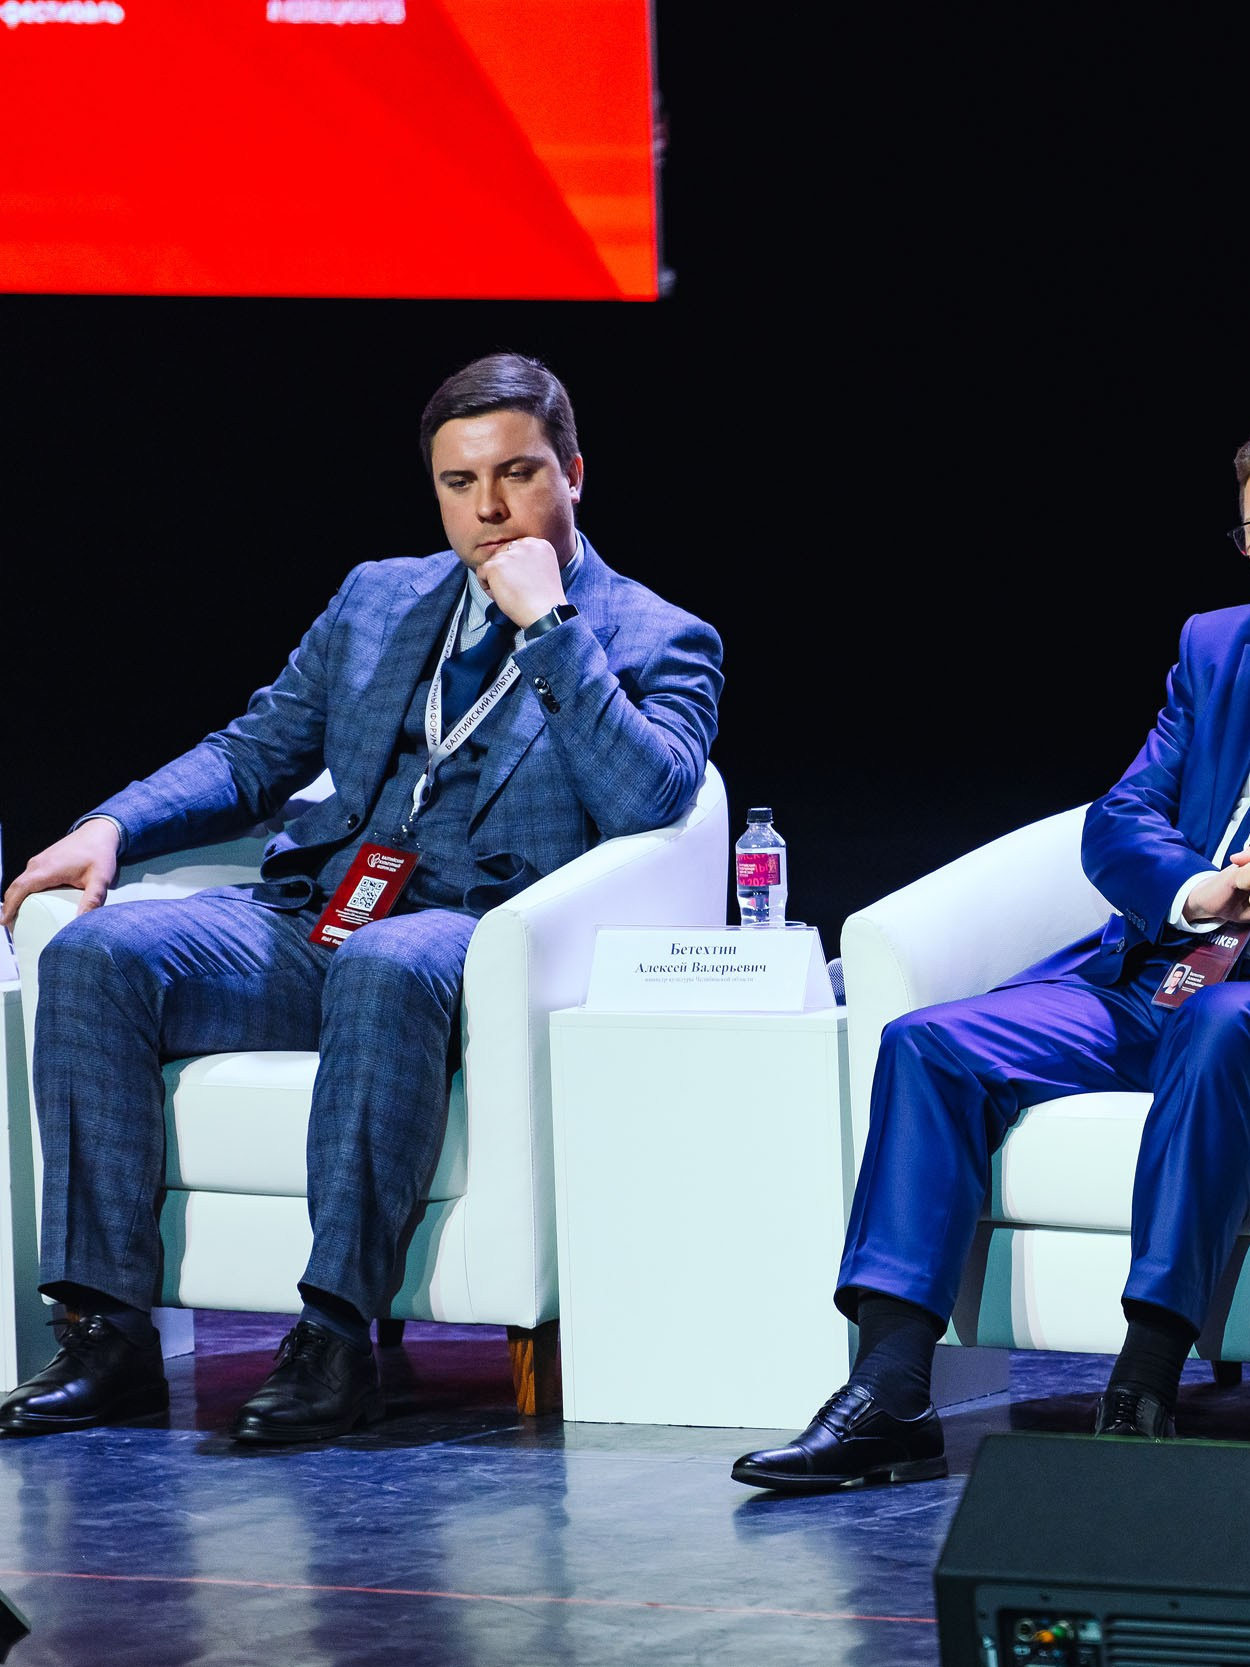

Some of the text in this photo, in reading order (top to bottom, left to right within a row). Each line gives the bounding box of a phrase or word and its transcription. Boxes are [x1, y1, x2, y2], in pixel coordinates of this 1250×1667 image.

[429, 712, 438, 746] ФОРУМ
[445, 696, 492, 751] БАЛТИЙСКИЙ
[670, 942, 738, 956] Бетехтин
[634, 961, 767, 976] Алексей Валерьевич
